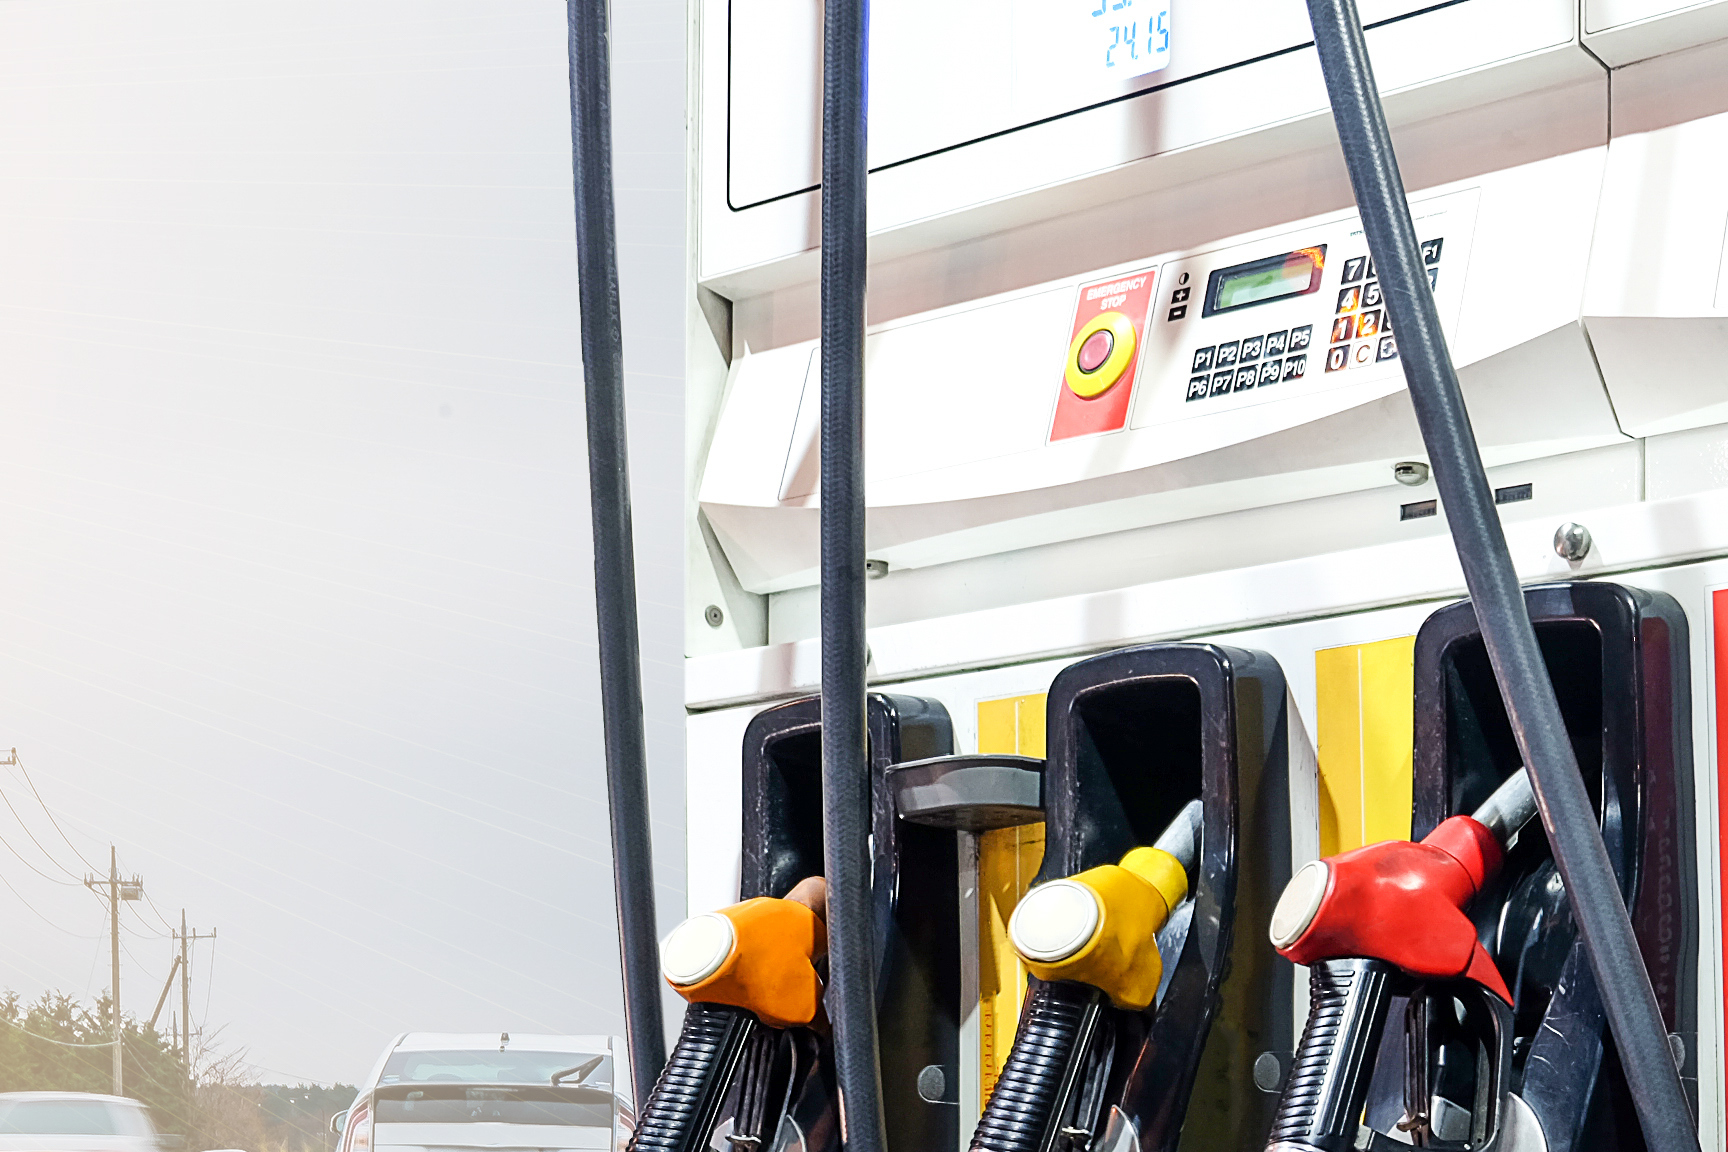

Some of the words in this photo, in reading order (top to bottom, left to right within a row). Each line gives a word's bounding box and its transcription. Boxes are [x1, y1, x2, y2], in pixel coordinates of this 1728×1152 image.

[1105, 10, 1169, 68] 24.15
[1348, 257, 1362, 281] 7
[1086, 275, 1147, 301] EMERGENCY
[1341, 289, 1354, 310] 4
[1366, 284, 1380, 306] 5
[1100, 294, 1127, 311] STOP
[1338, 318, 1348, 340] 1
[1361, 313, 1375, 334] 2
[1194, 351, 1212, 369] P1
[1218, 345, 1237, 364] P2
[1242, 341, 1261, 359] P3
[1266, 335, 1285, 354] P4
[1290, 330, 1310, 348] P5
[1330, 349, 1344, 370] 0
[1355, 344, 1370, 363] C
[1188, 381, 1207, 398] P6
[1212, 376, 1232, 393] P7
[1236, 370, 1256, 388] P8
[1260, 365, 1280, 383] P9
[1283, 359, 1306, 378] P10
